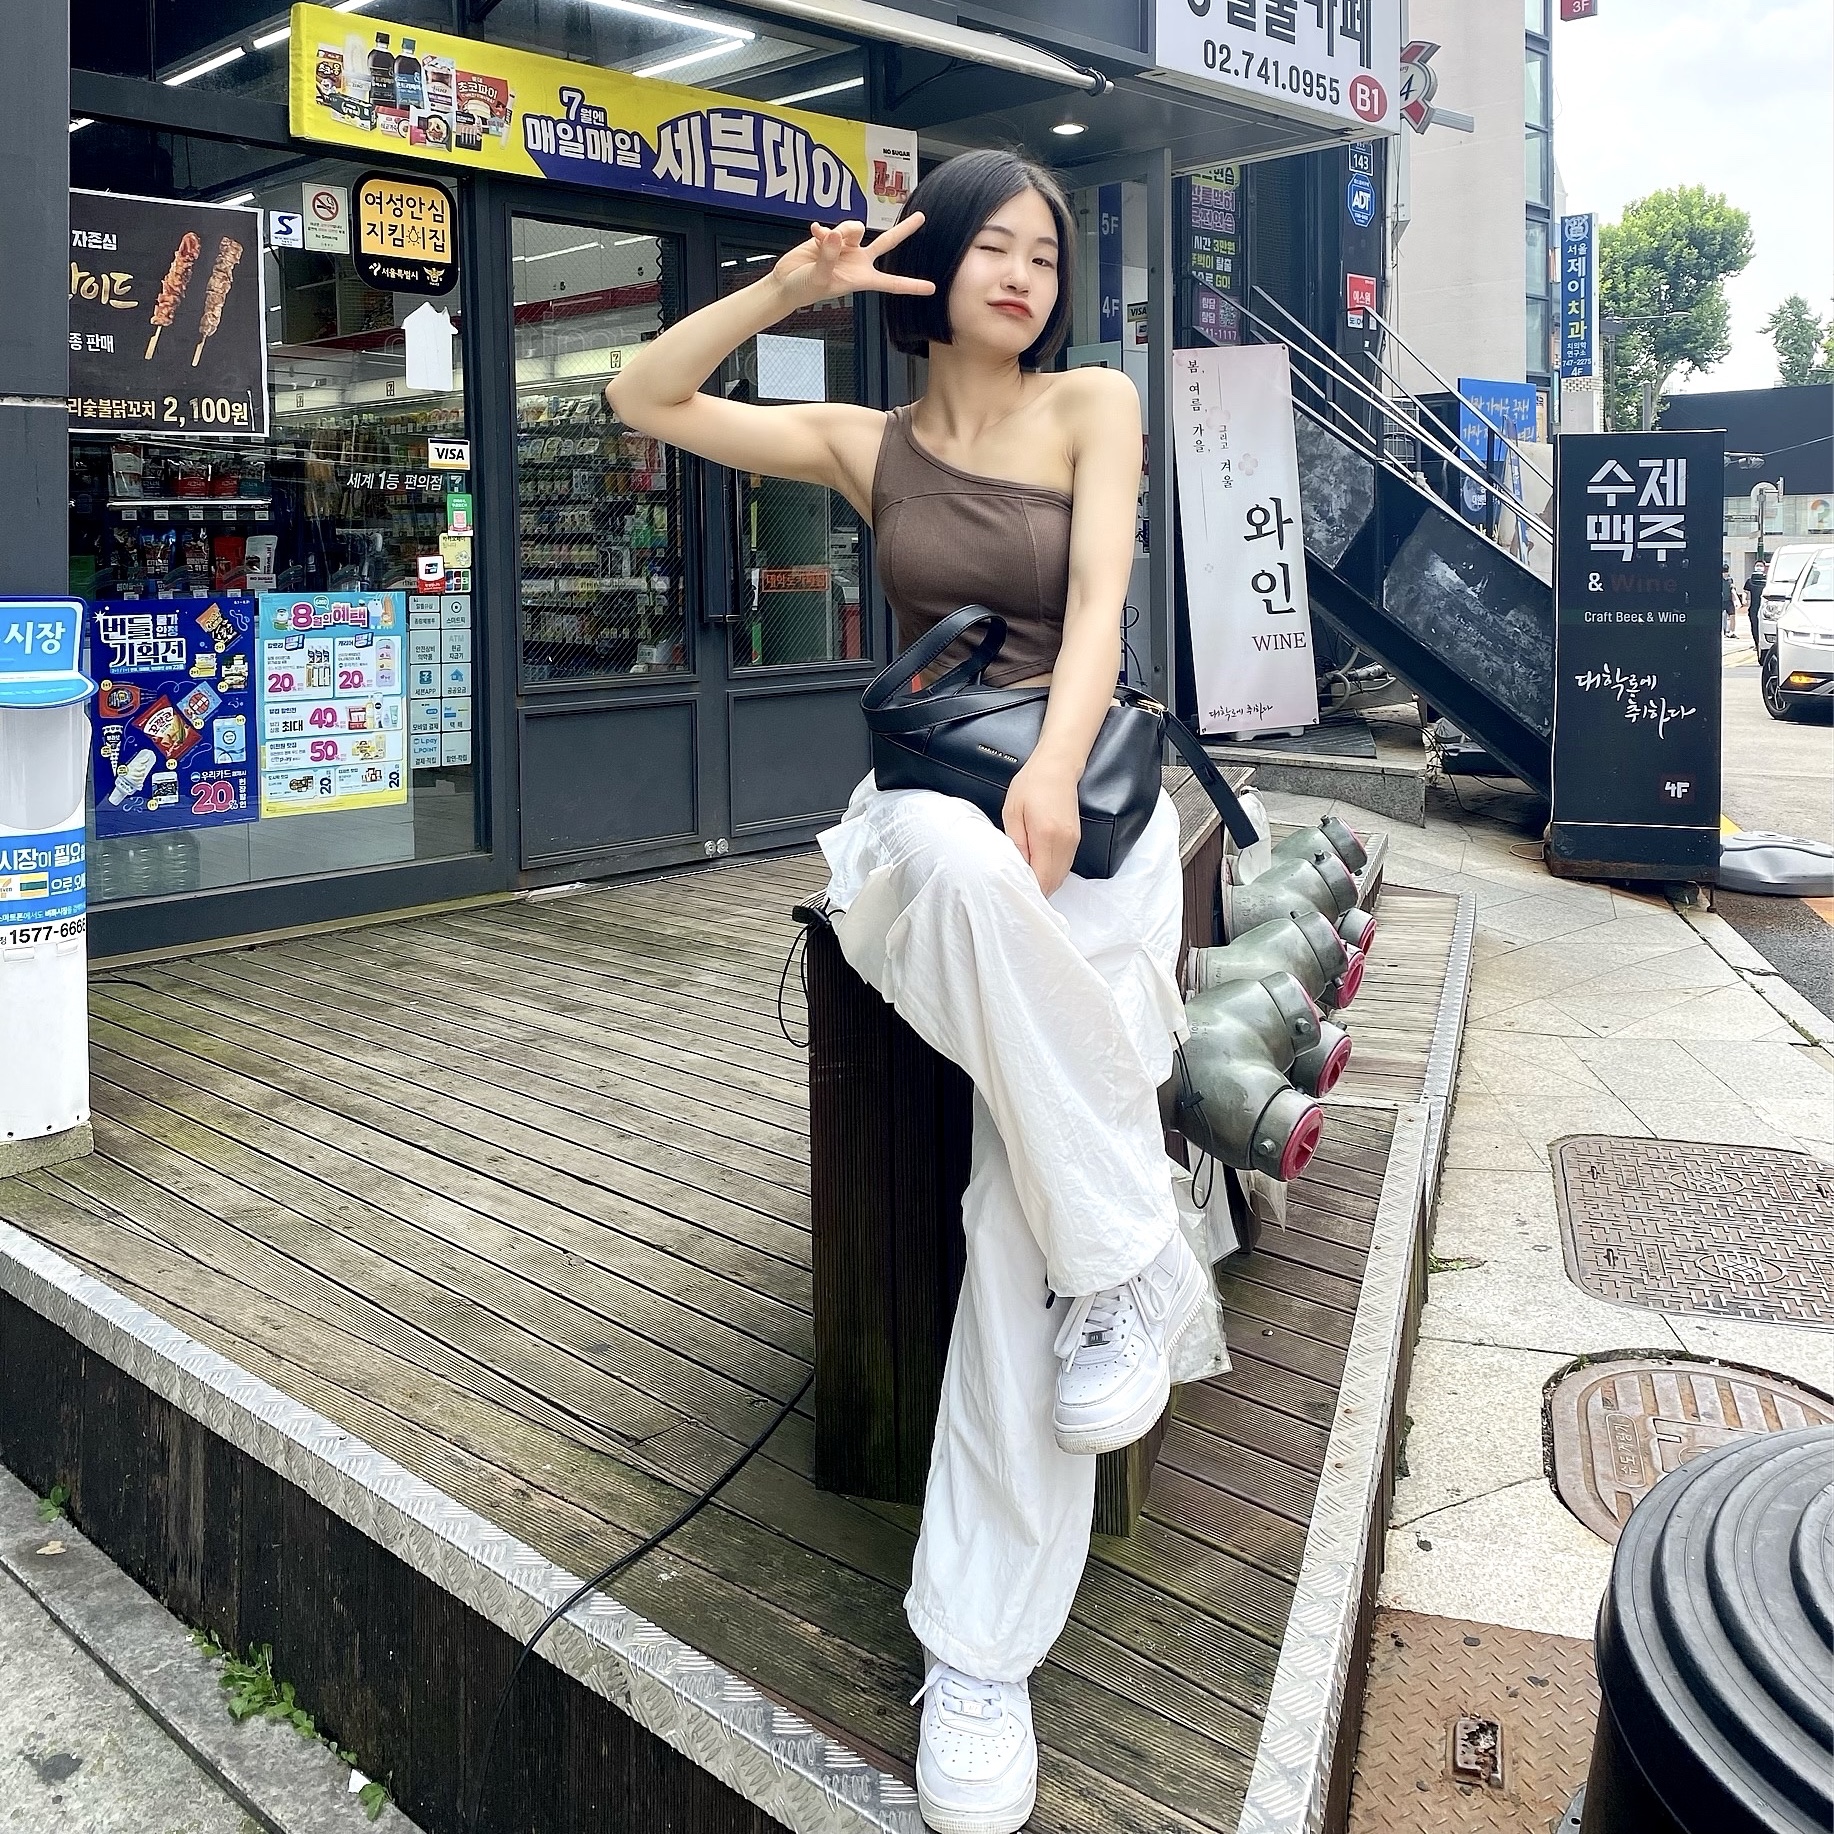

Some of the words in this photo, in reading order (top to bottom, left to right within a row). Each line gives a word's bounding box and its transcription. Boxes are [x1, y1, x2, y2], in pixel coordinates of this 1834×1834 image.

[1573, 1, 1589, 13] 3F
[1203, 39, 1340, 105] 02.741.0955
[562, 90, 605, 127] 7월엔
[1356, 82, 1380, 116] B1
[525, 117, 642, 169] 매일매일
[652, 113, 853, 211] 세븐데이
[1353, 153, 1369, 170] 143
[364, 190, 445, 224] 여성안심
[1352, 190, 1371, 211] ADT
[1101, 212, 1119, 235] 5F
[71, 229, 118, 251] 자존심
[1213, 238, 1236, 256] 3만원
[1567, 243, 1588, 255] 서울
[381, 267, 419, 281] 서울특별시
[1215, 274, 1231, 290] GO!
[1102, 295, 1120, 319] 4F
[1566, 256, 1588, 341] 제이치과
[1130, 307, 1147, 317] VISA
[86, 333, 115, 353] 판매
[163, 395, 250, 428] 2,100원
[1218, 424, 1229, 449] 그리고
[434, 447, 465, 460] VISA
[346, 472, 375, 490] 세계
[378, 470, 400, 490] 1등
[404, 474, 443, 491] 편의점
[1220, 459, 1234, 489] 겨울
[1586, 457, 1687, 508] 수제
[1586, 513, 1687, 563] 맥주
[1243, 496, 1297, 616] 와인
[1587, 572, 1604, 592] &
[1584, 611, 1613, 623] Craft
[1646, 611, 1655, 623] &
[1657, 611, 1686, 623] Wine
[3, 620, 66, 655] 시장
[448, 634, 464, 642] ATM
[1251, 632, 1307, 652] WINE
[109, 639, 186, 668] 기획전
[282, 719, 303, 733] 최대
[1624, 697, 1697, 740] 취하다
[201, 770, 231, 781] 우리카드
[1664, 781, 1690, 799] 4F
[0, 847, 52, 871] 시장이
[50, 876, 73, 896] 으로
